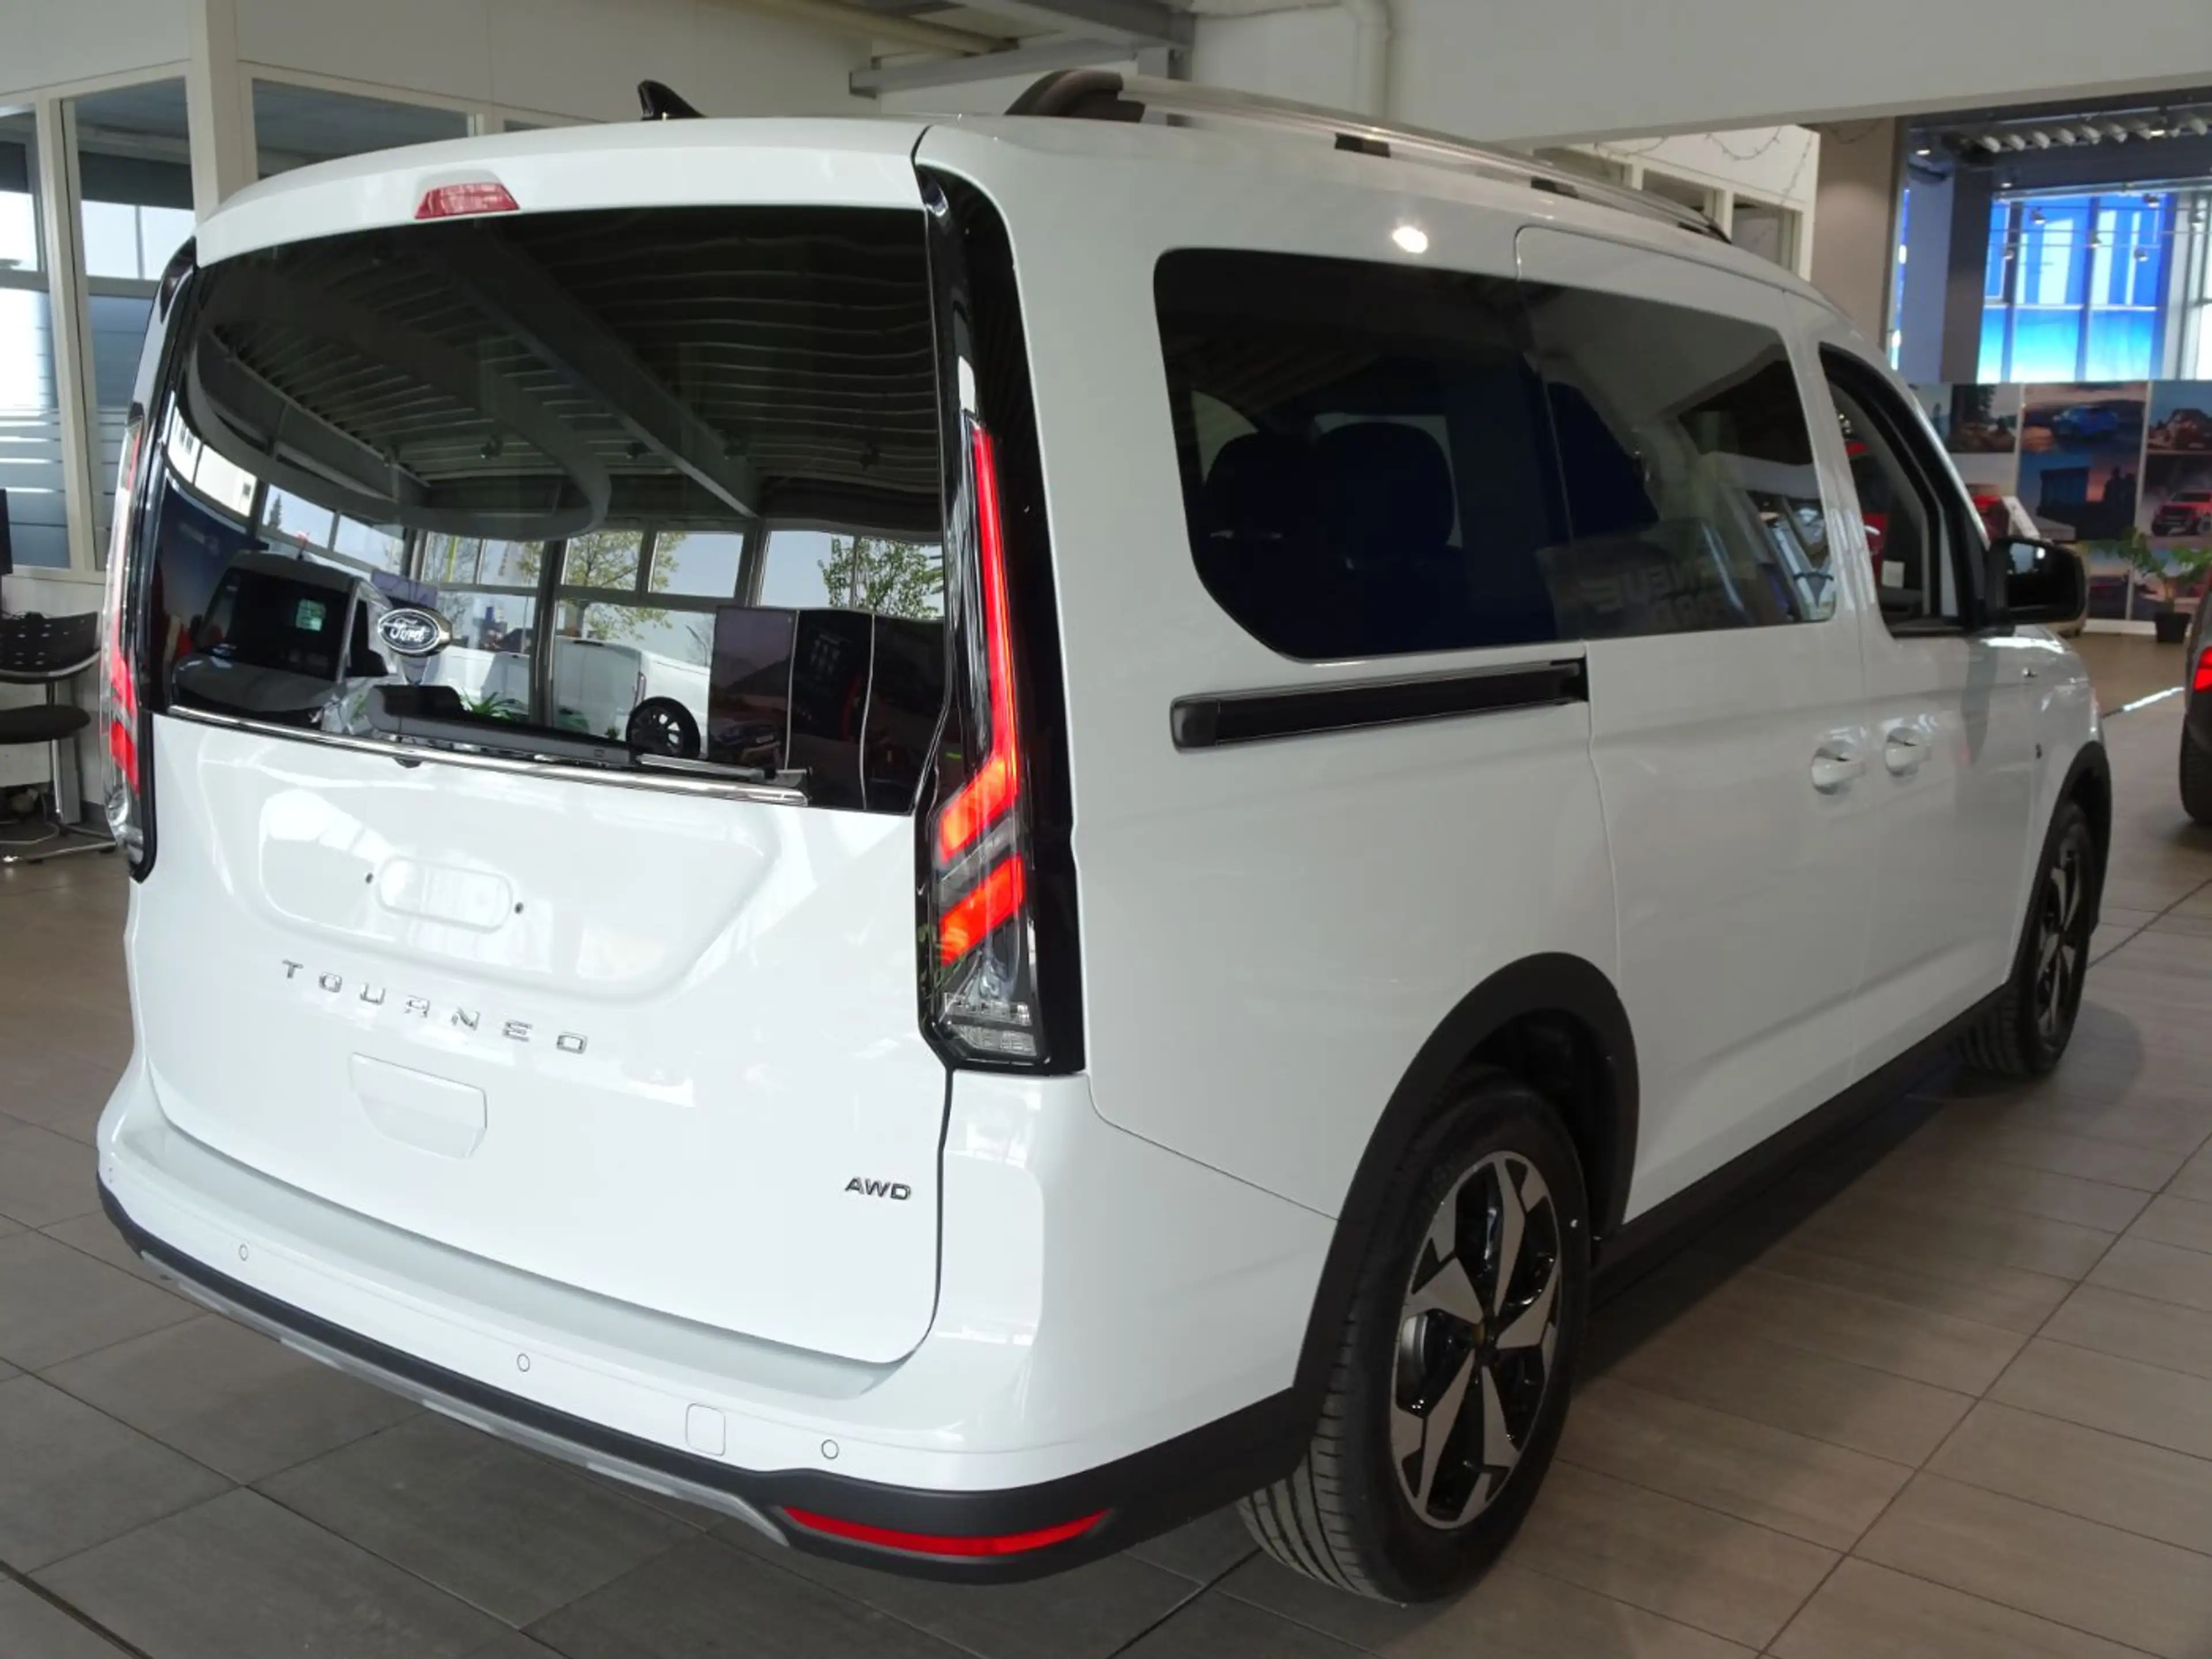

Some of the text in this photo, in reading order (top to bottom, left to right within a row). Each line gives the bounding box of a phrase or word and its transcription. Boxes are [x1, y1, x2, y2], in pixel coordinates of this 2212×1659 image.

[383, 617, 430, 643] Ford
[282, 959, 589, 1055] TOURNEO
[844, 1176, 911, 1200] AWD
